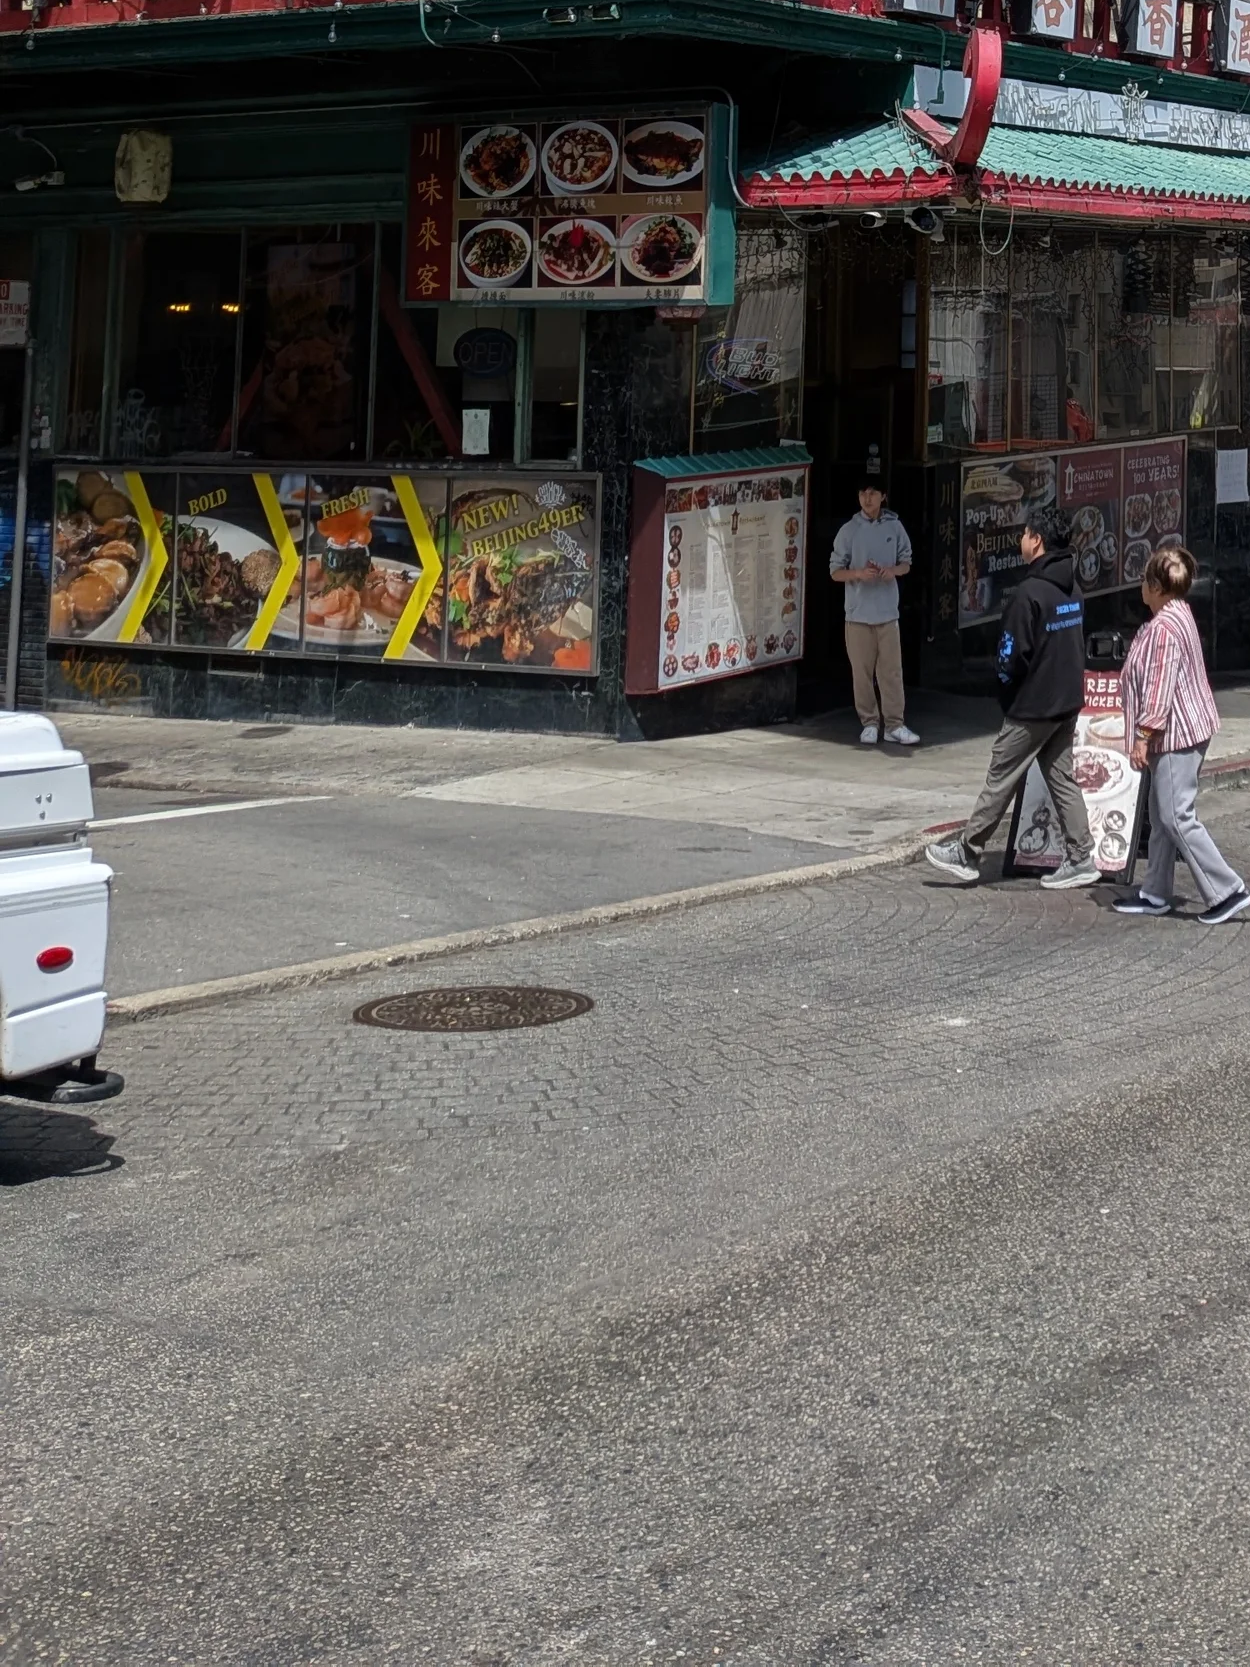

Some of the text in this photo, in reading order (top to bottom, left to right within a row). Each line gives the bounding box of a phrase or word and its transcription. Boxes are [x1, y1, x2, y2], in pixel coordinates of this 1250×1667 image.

[416, 128, 444, 296] 川味來客
[459, 341, 513, 365] OPEN
[728, 346, 780, 367] BUD
[715, 359, 780, 381] LIGHT
[1127, 454, 1170, 471] CELEBRATING
[1133, 464, 1180, 485] 100 YEARS!
[1073, 468, 1114, 484] CHINATOWN
[188, 488, 228, 516] BOLD
[320, 487, 371, 520] FRESH
[461, 493, 519, 533] NEW!
[965, 505, 1005, 529] Pop-Up
